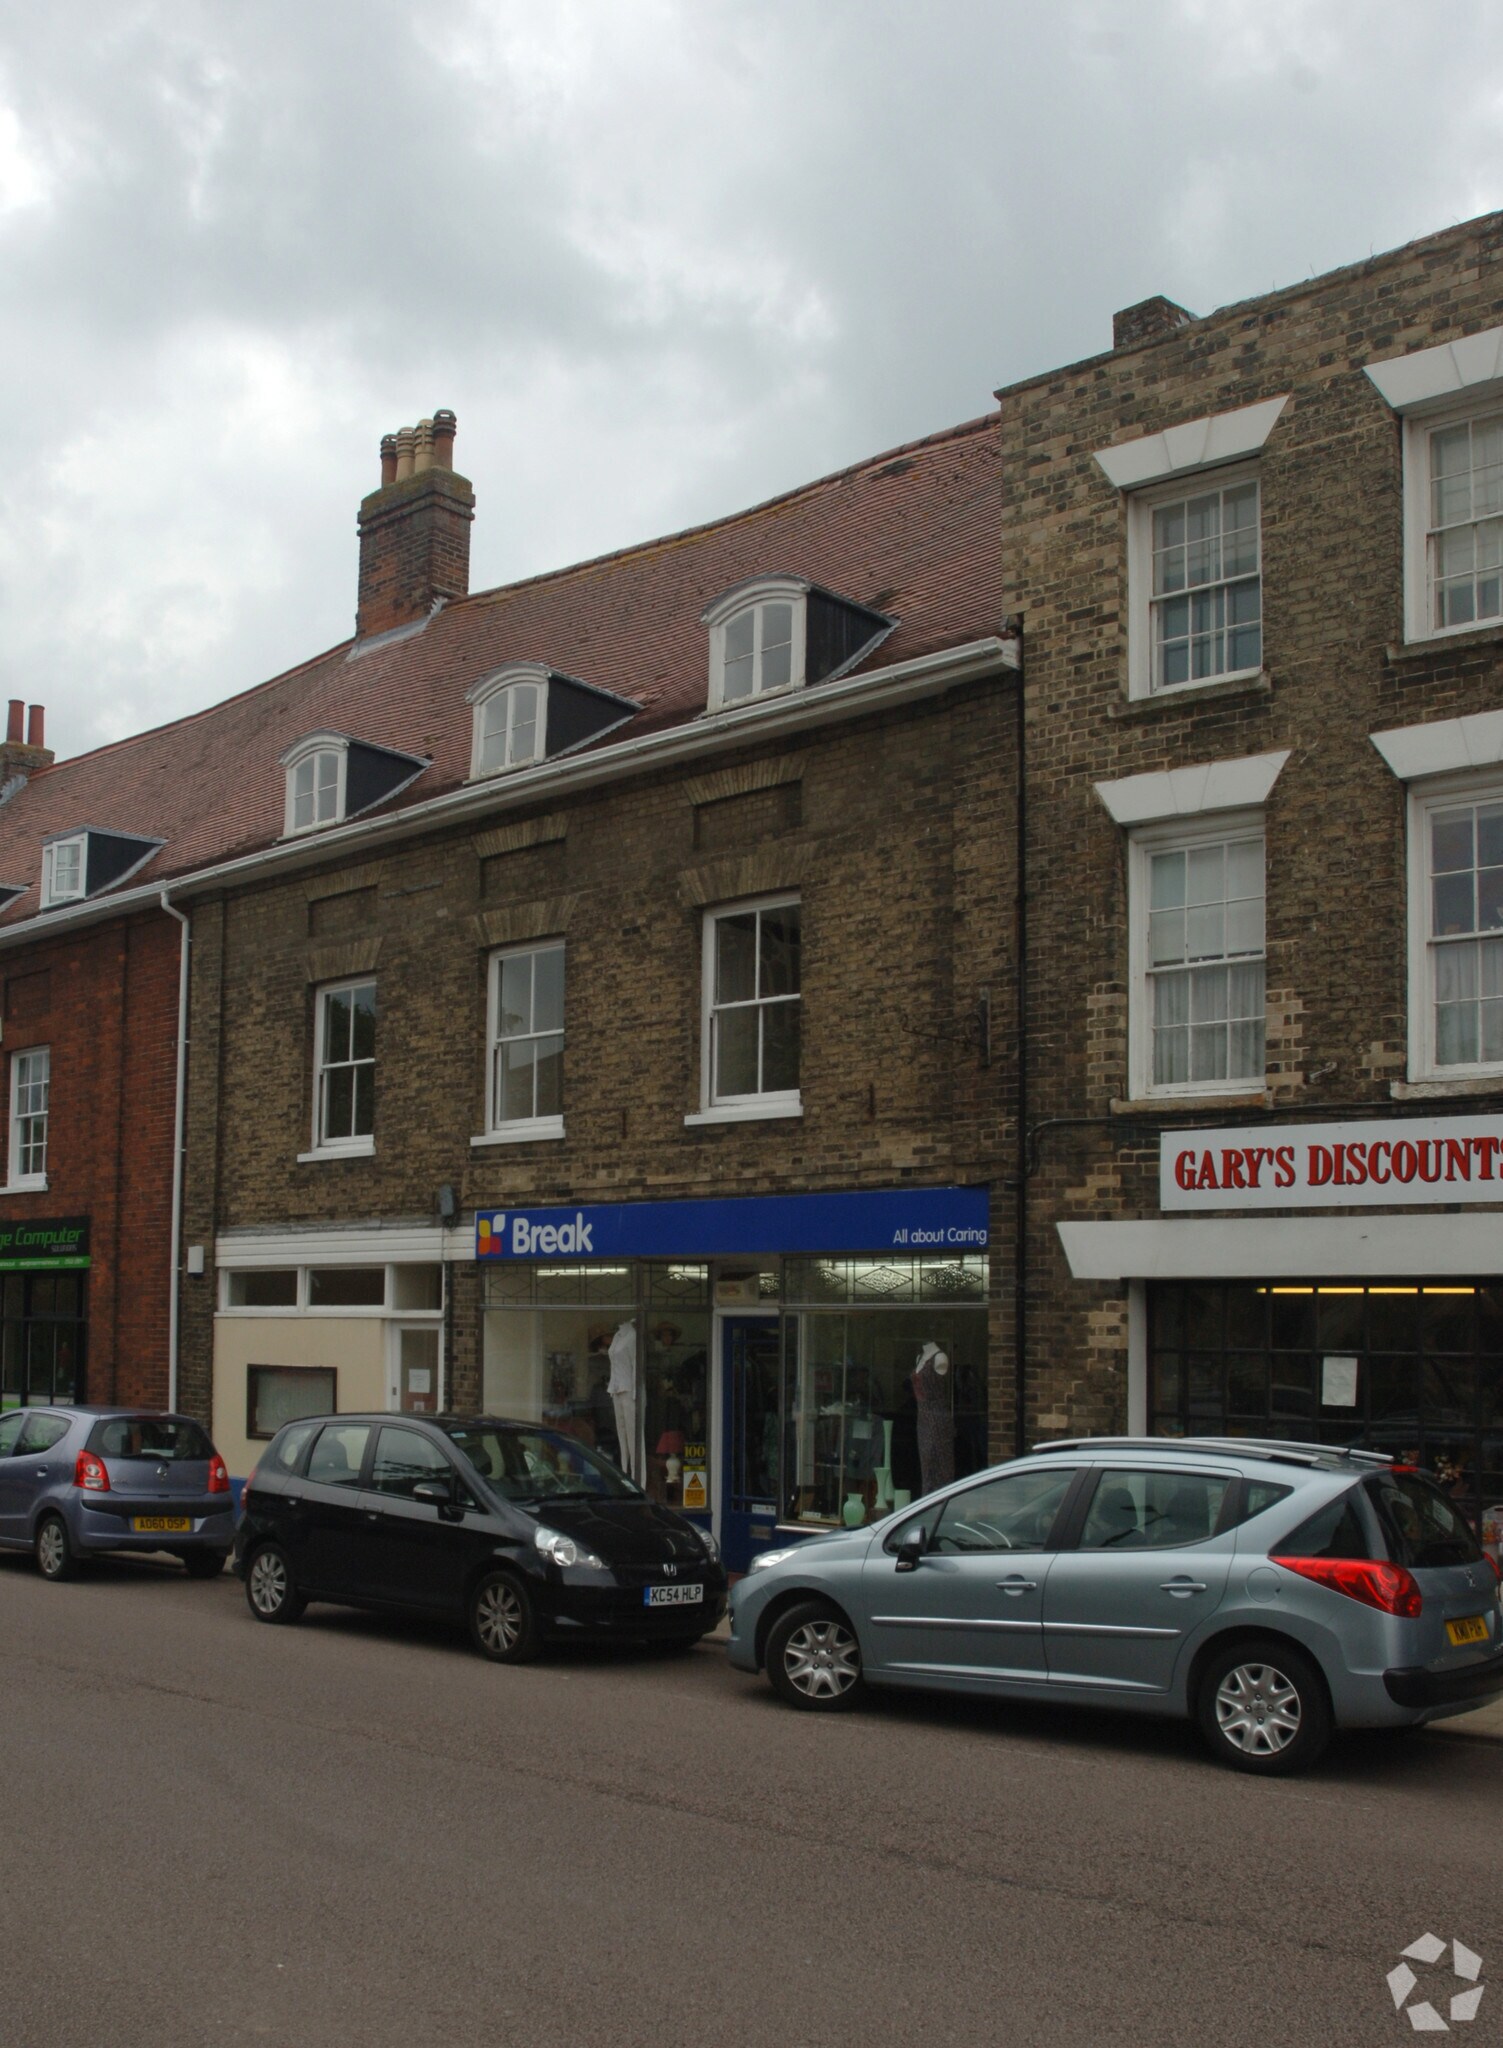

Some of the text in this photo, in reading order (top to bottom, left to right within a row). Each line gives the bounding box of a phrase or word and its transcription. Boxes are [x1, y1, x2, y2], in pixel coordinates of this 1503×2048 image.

[1175, 1137, 1503, 1190] GARY'S DISCOUNT
[15, 1226, 85, 1249] Computer
[513, 1211, 593, 1254] Break
[893, 1226, 987, 1245] All about Caring
[684, 1446, 705, 1458] 100
[651, 1586, 702, 1602] KC54 HLP
